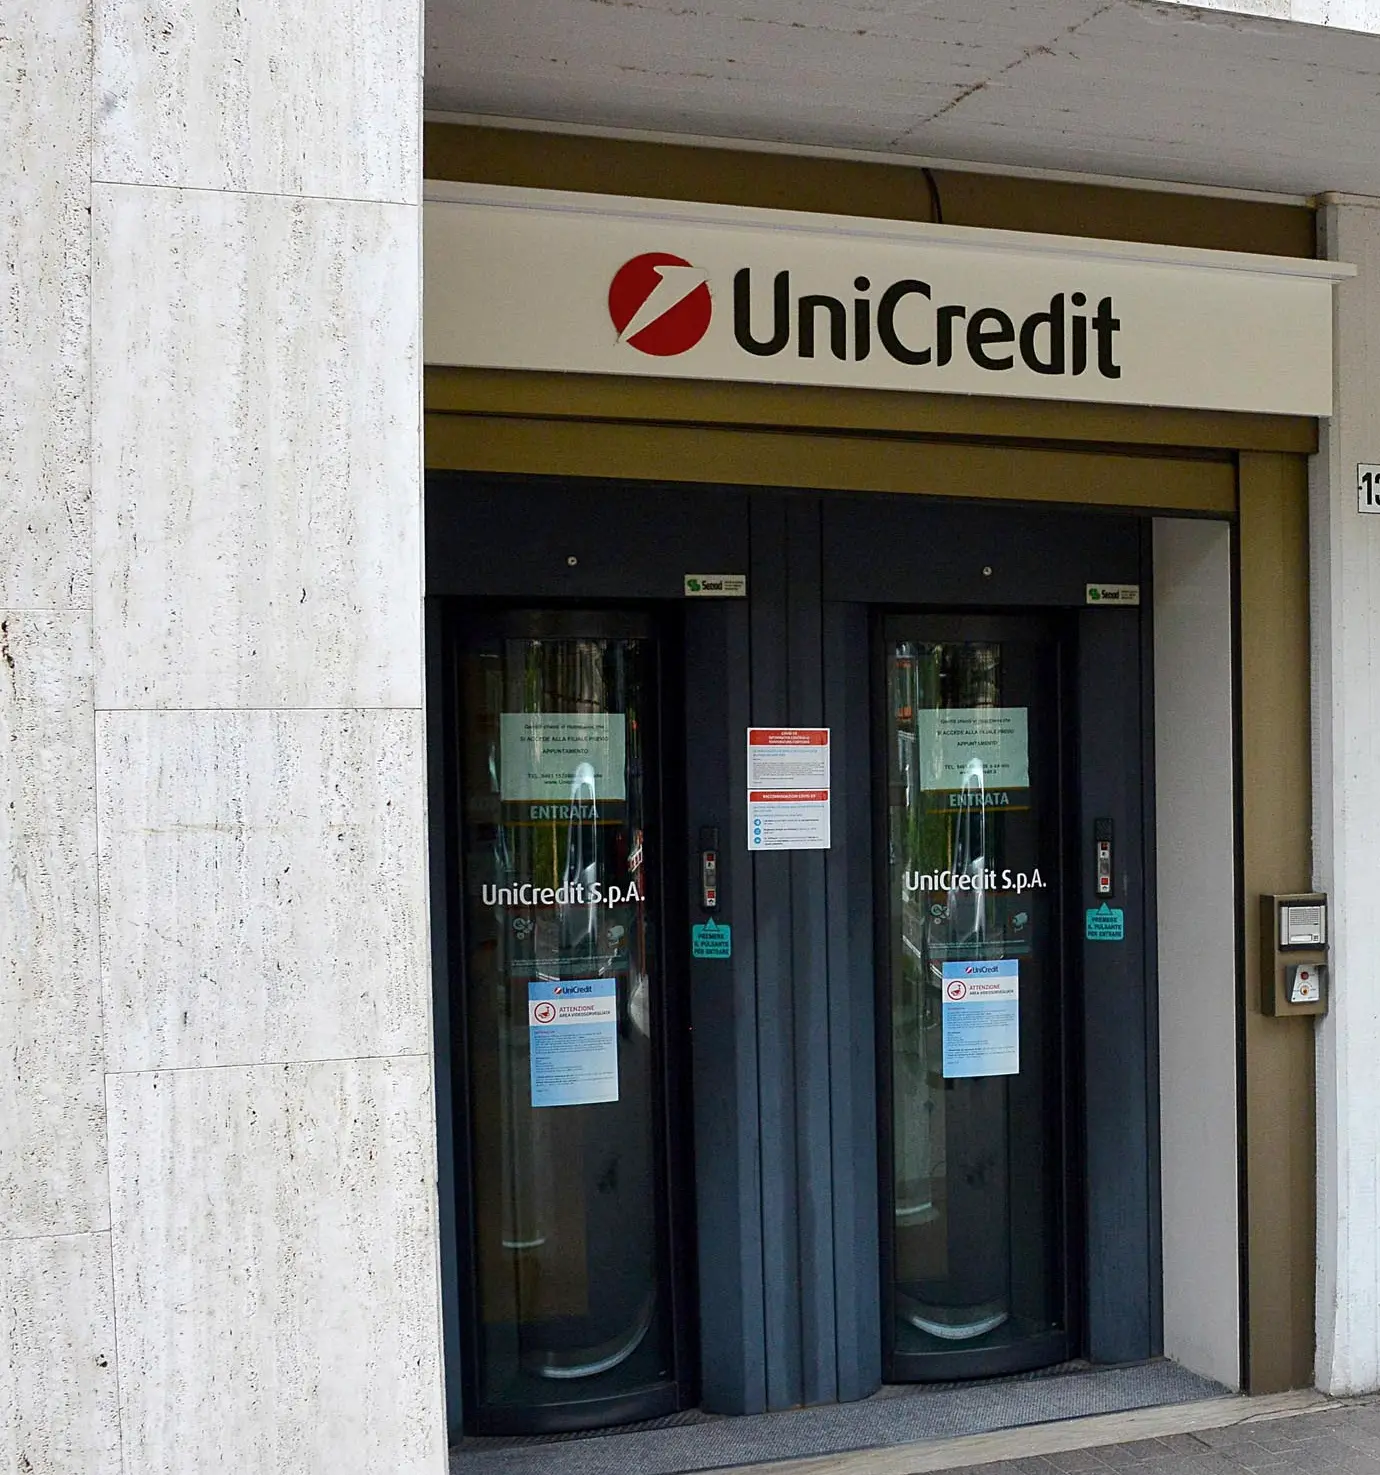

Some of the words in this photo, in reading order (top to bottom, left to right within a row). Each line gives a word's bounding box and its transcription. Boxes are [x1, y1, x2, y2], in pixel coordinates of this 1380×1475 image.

[733, 266, 1121, 379] UniCredit
[948, 791, 1010, 807] ENTRATA
[530, 804, 600, 820] ENTRATA
[905, 868, 997, 891] UniCredit
[1001, 868, 1047, 895] S.p.A.
[482, 881, 585, 906] UniCredit
[589, 881, 646, 909] S.p.A.
[972, 965, 999, 974] UniCredit
[562, 985, 593, 995] UniCredit
[559, 1004, 595, 1013] ATTENZIONE
